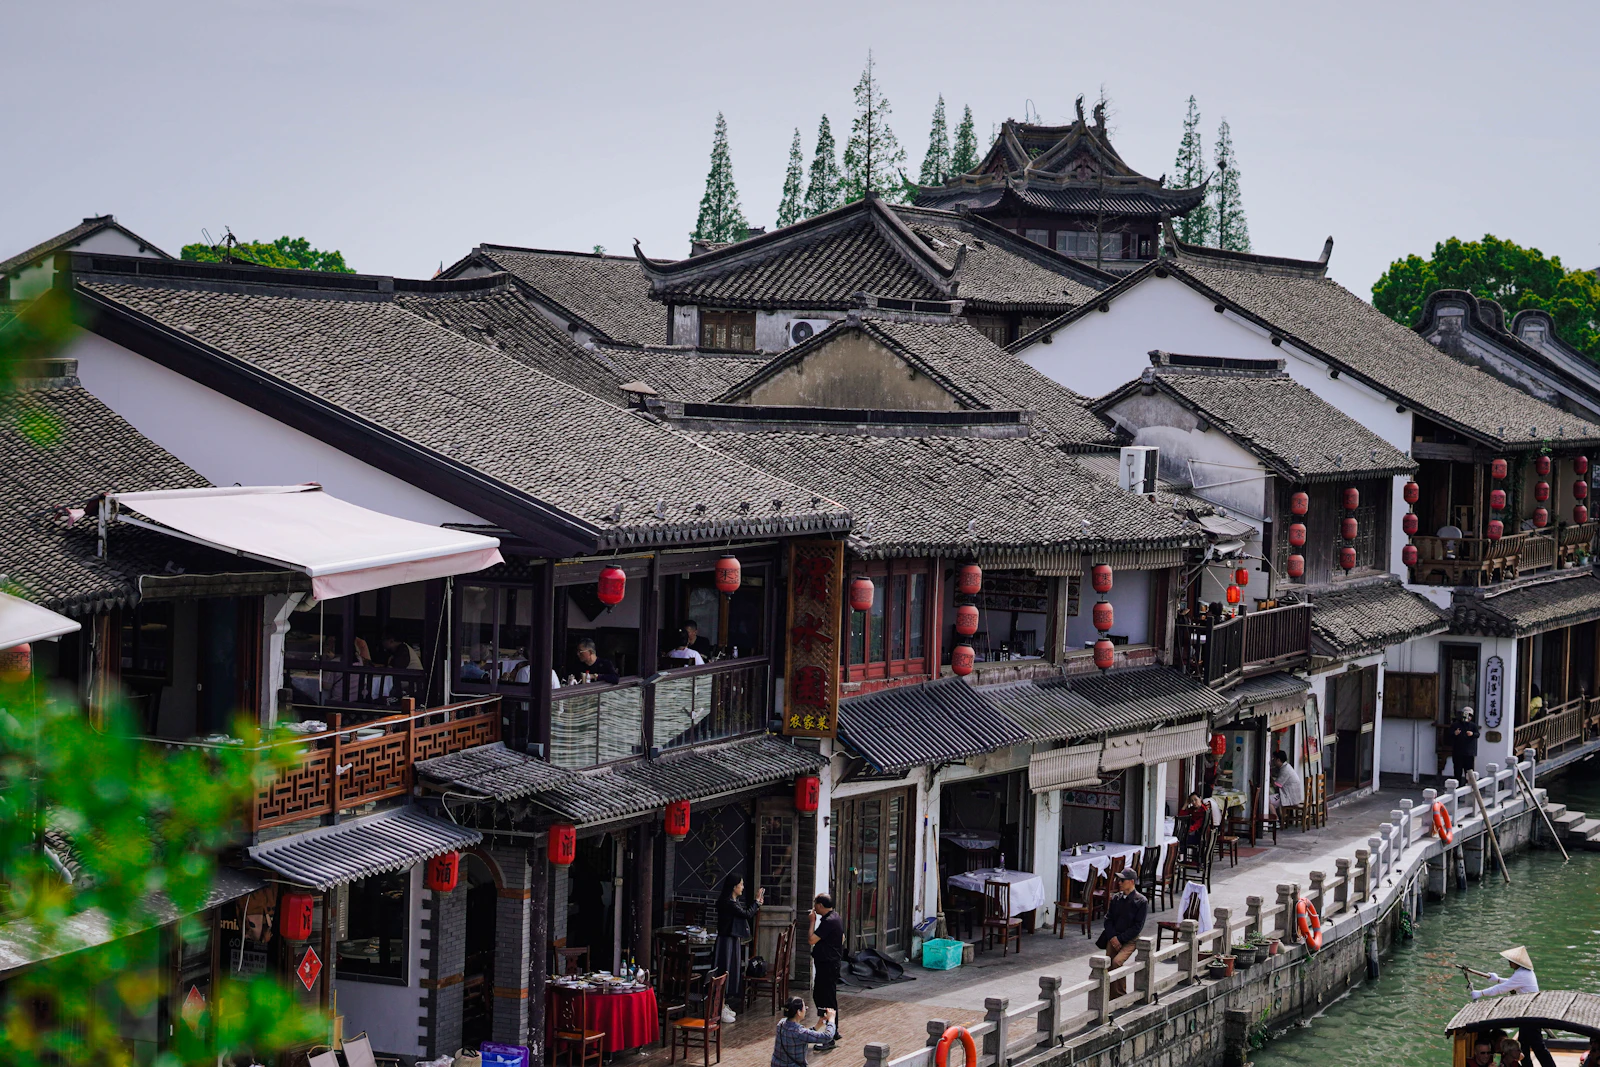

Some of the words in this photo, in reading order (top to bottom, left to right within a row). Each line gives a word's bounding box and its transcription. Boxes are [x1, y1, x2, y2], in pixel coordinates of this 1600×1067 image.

[789, 713, 830, 731] 农家菜
[673, 807, 686, 828] 酒
[561, 833, 574, 857] 酒
[435, 860, 453, 884] 酒
[228, 937, 241, 948] 60
